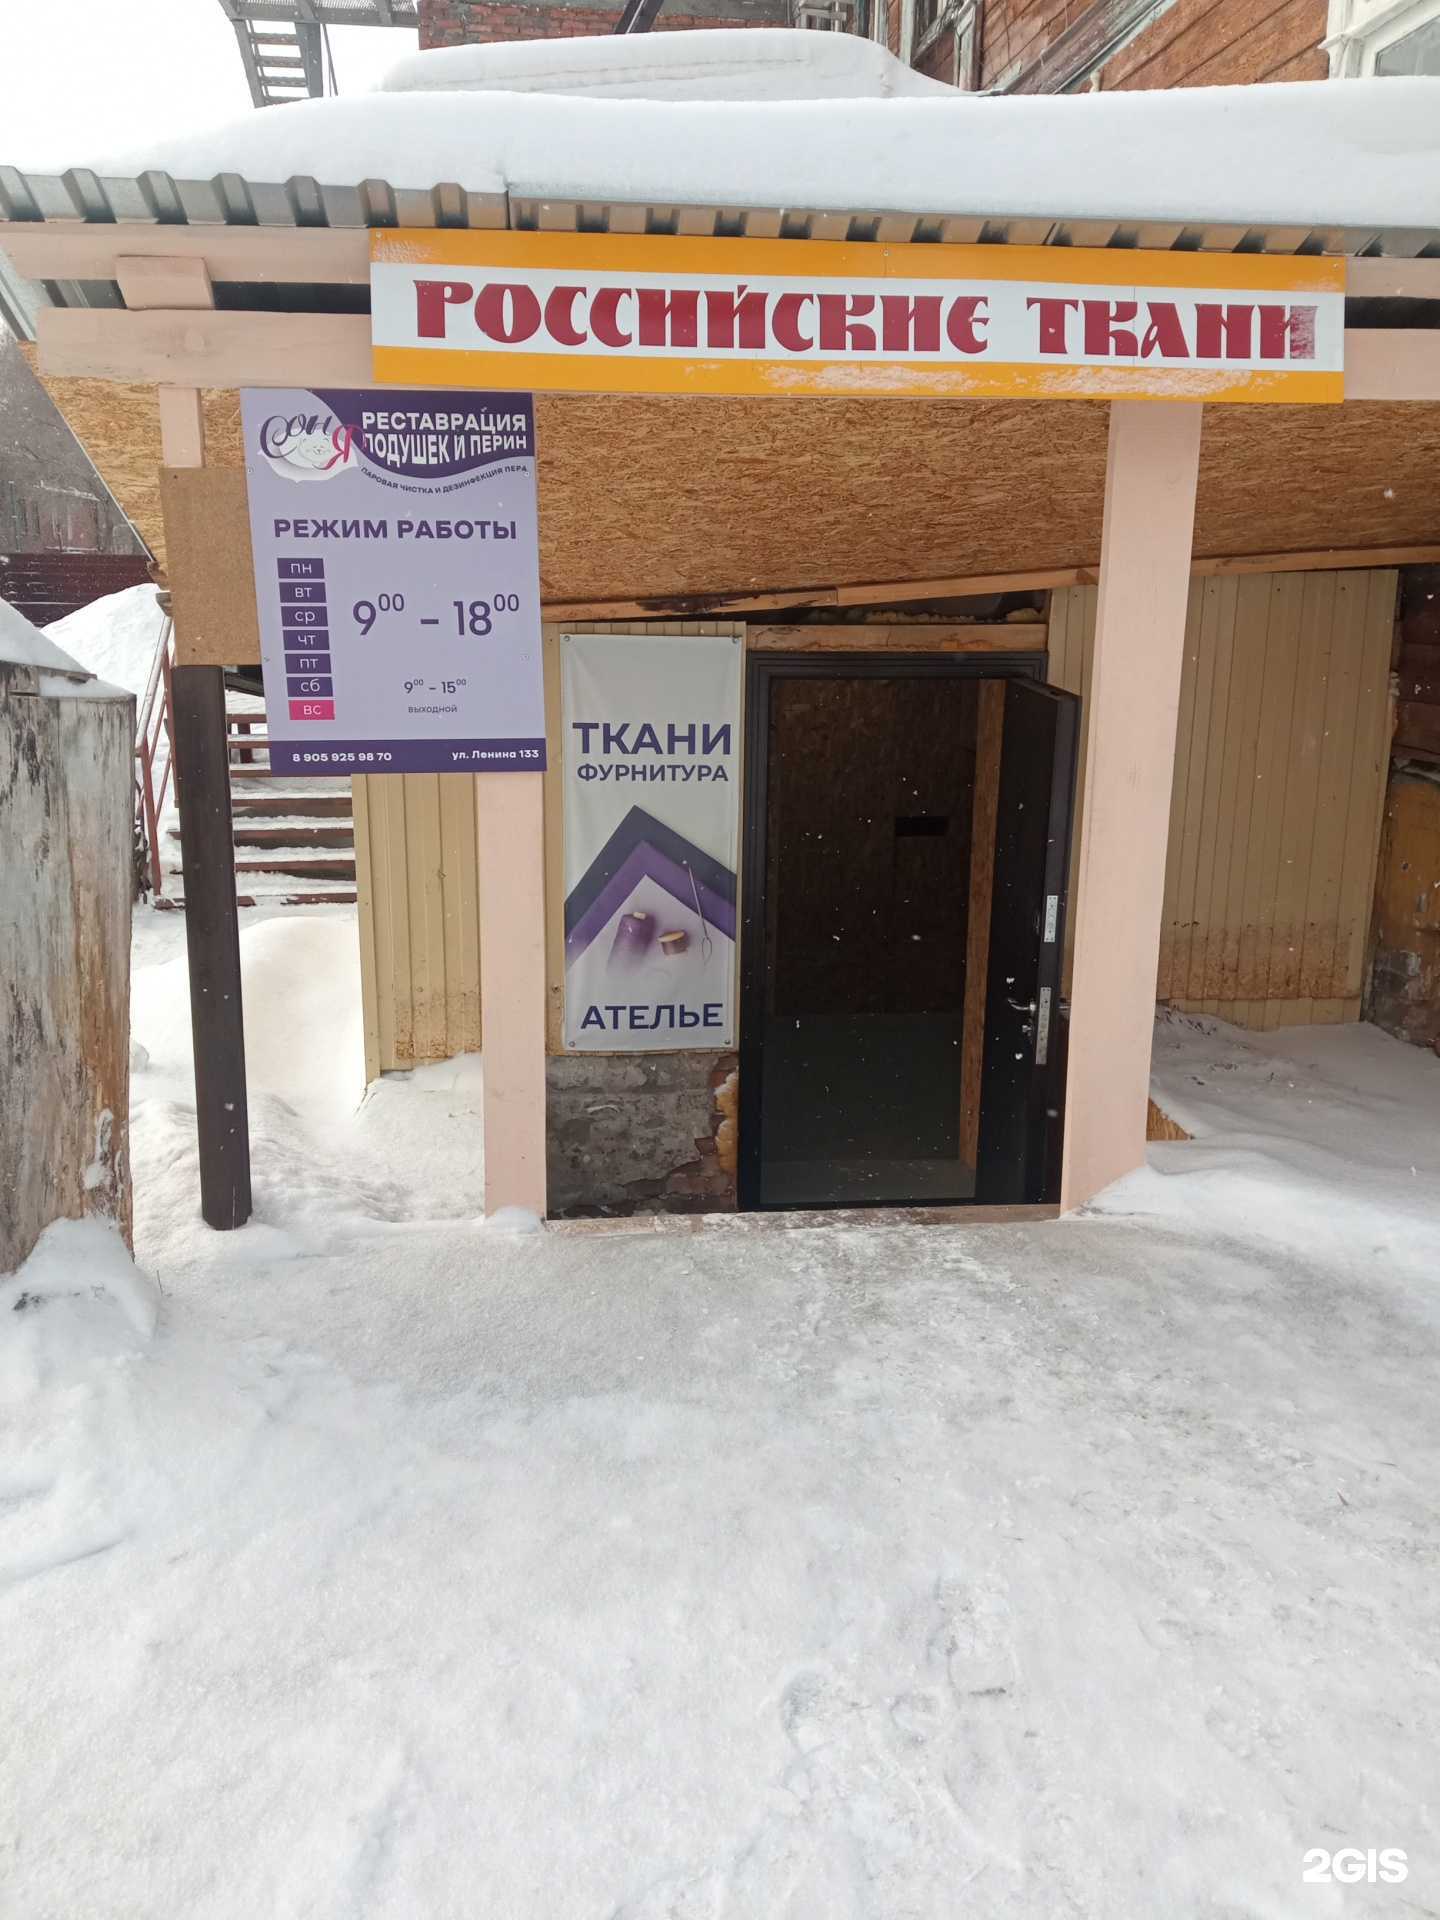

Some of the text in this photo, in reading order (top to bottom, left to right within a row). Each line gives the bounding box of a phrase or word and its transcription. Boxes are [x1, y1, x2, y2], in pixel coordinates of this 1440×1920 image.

[413, 280, 1318, 359] РОССИЙСКИЕ ТКАНИ
[362, 412, 527, 434] РЕСТАВРАЦИЯ
[364, 433, 527, 468] ПОДУШЕК И ПЕРИН
[361, 467, 399, 489] ПАРОВАЯ
[400, 485, 433, 494] ЧИСТКА
[443, 468, 503, 493] ДЕЗИНФЕКЦИЯ
[505, 465, 527, 473] ПЕРА
[274, 519, 517, 540] РЕЖИМ РАБОТЫ
[294, 611, 316, 624] ср
[300, 678, 321, 692] сб
[408, 705, 458, 713] выходной
[572, 722, 731, 755] ТКАНИ
[292, 752, 392, 762] 8 905 925 98 70
[452, 750, 539, 760] ул. Ленина 133
[577, 763, 729, 782] ФУРНИТУРА
[580, 1003, 723, 1030] АТЕЛЬЕ
